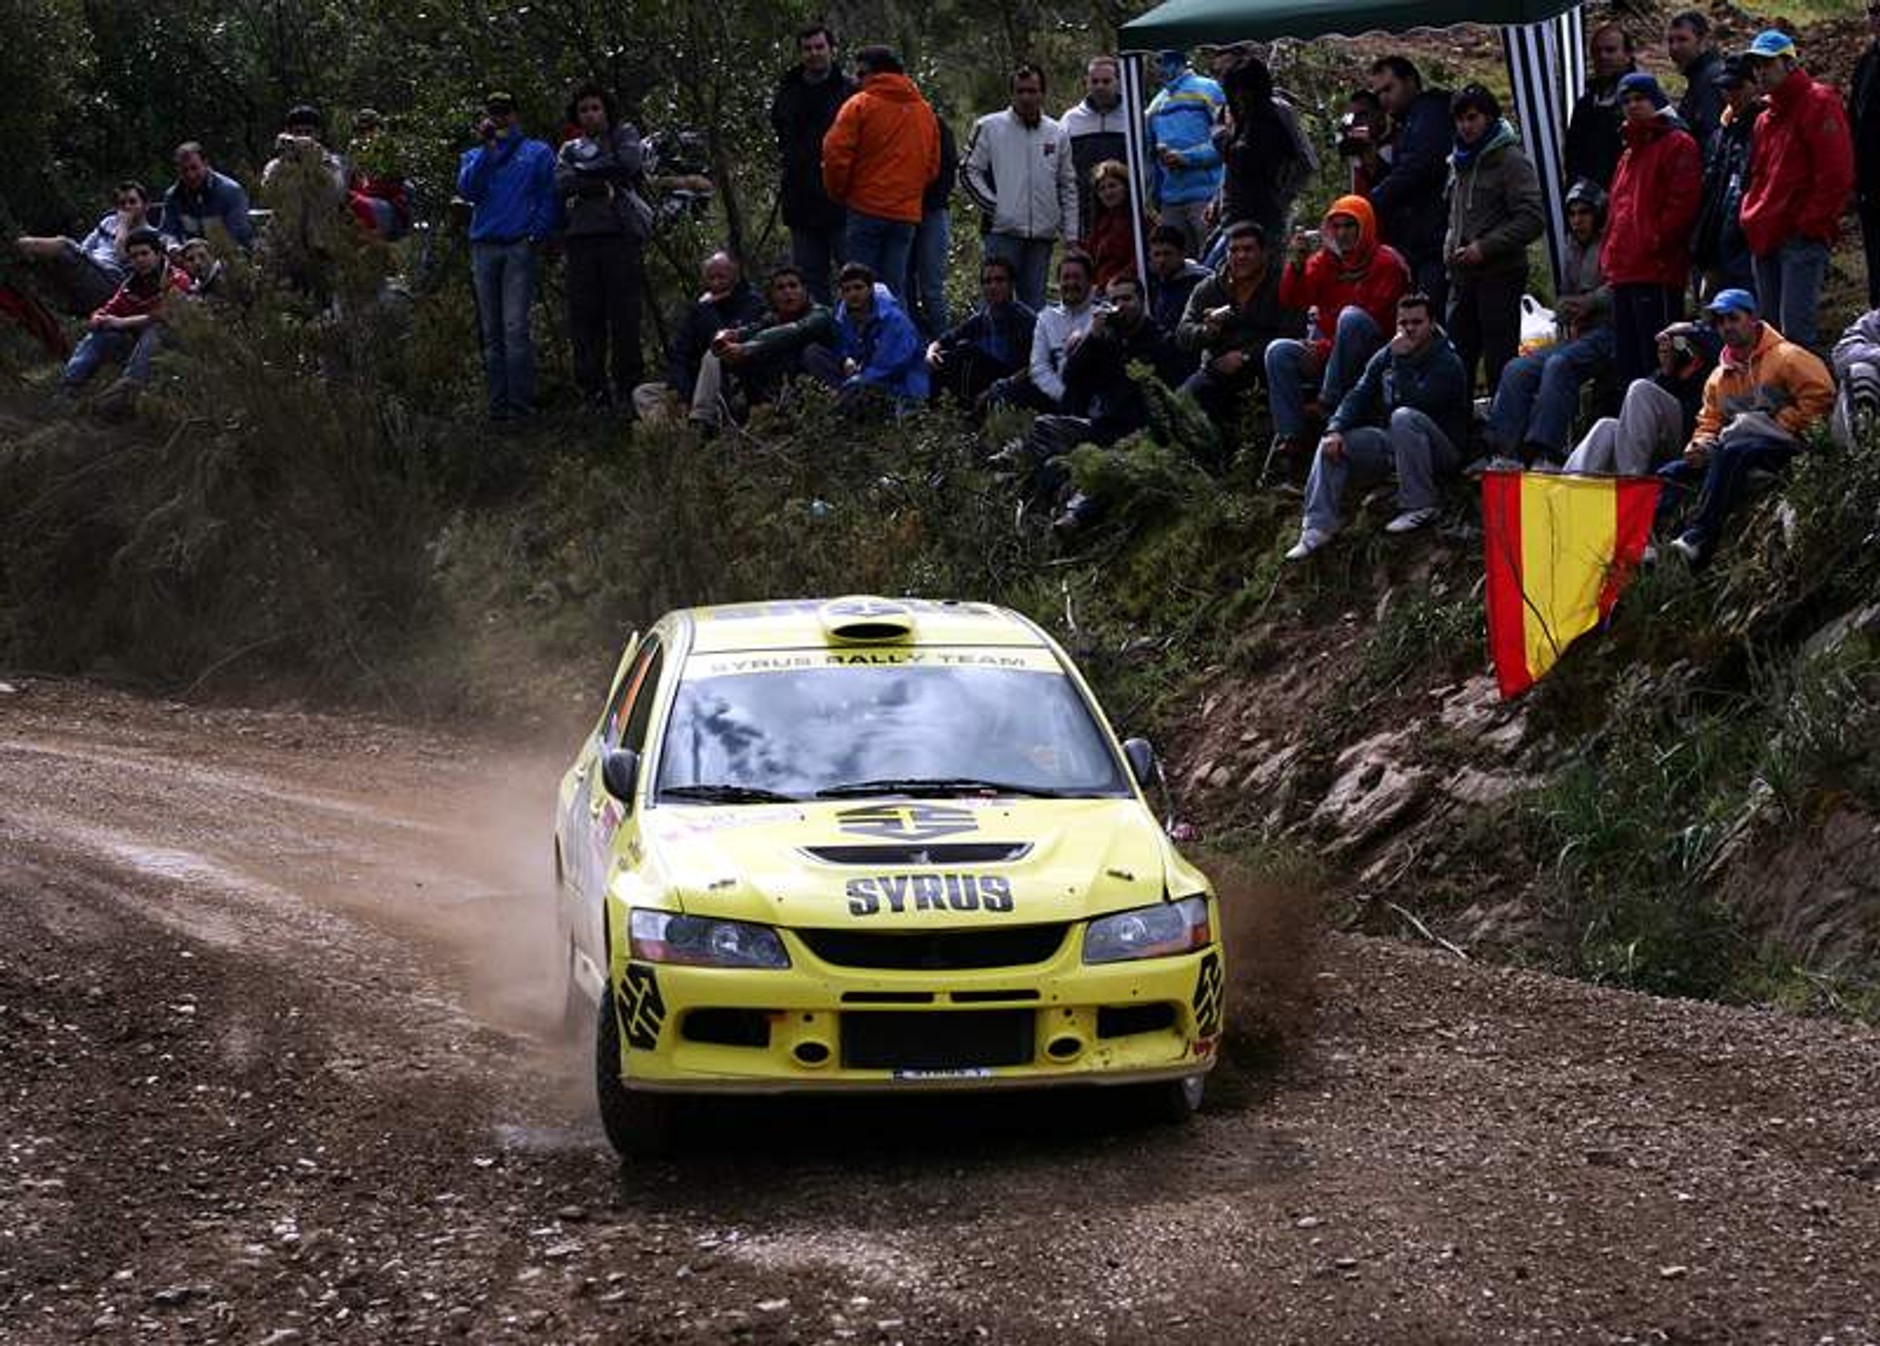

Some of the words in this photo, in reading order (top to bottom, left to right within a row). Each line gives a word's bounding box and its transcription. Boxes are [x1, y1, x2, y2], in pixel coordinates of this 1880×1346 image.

[711, 657, 811, 673] SYRUS
[825, 653, 924, 665] RALLY
[939, 653, 1025, 667] TEAM
[846, 874, 1014, 916] SYRUS
